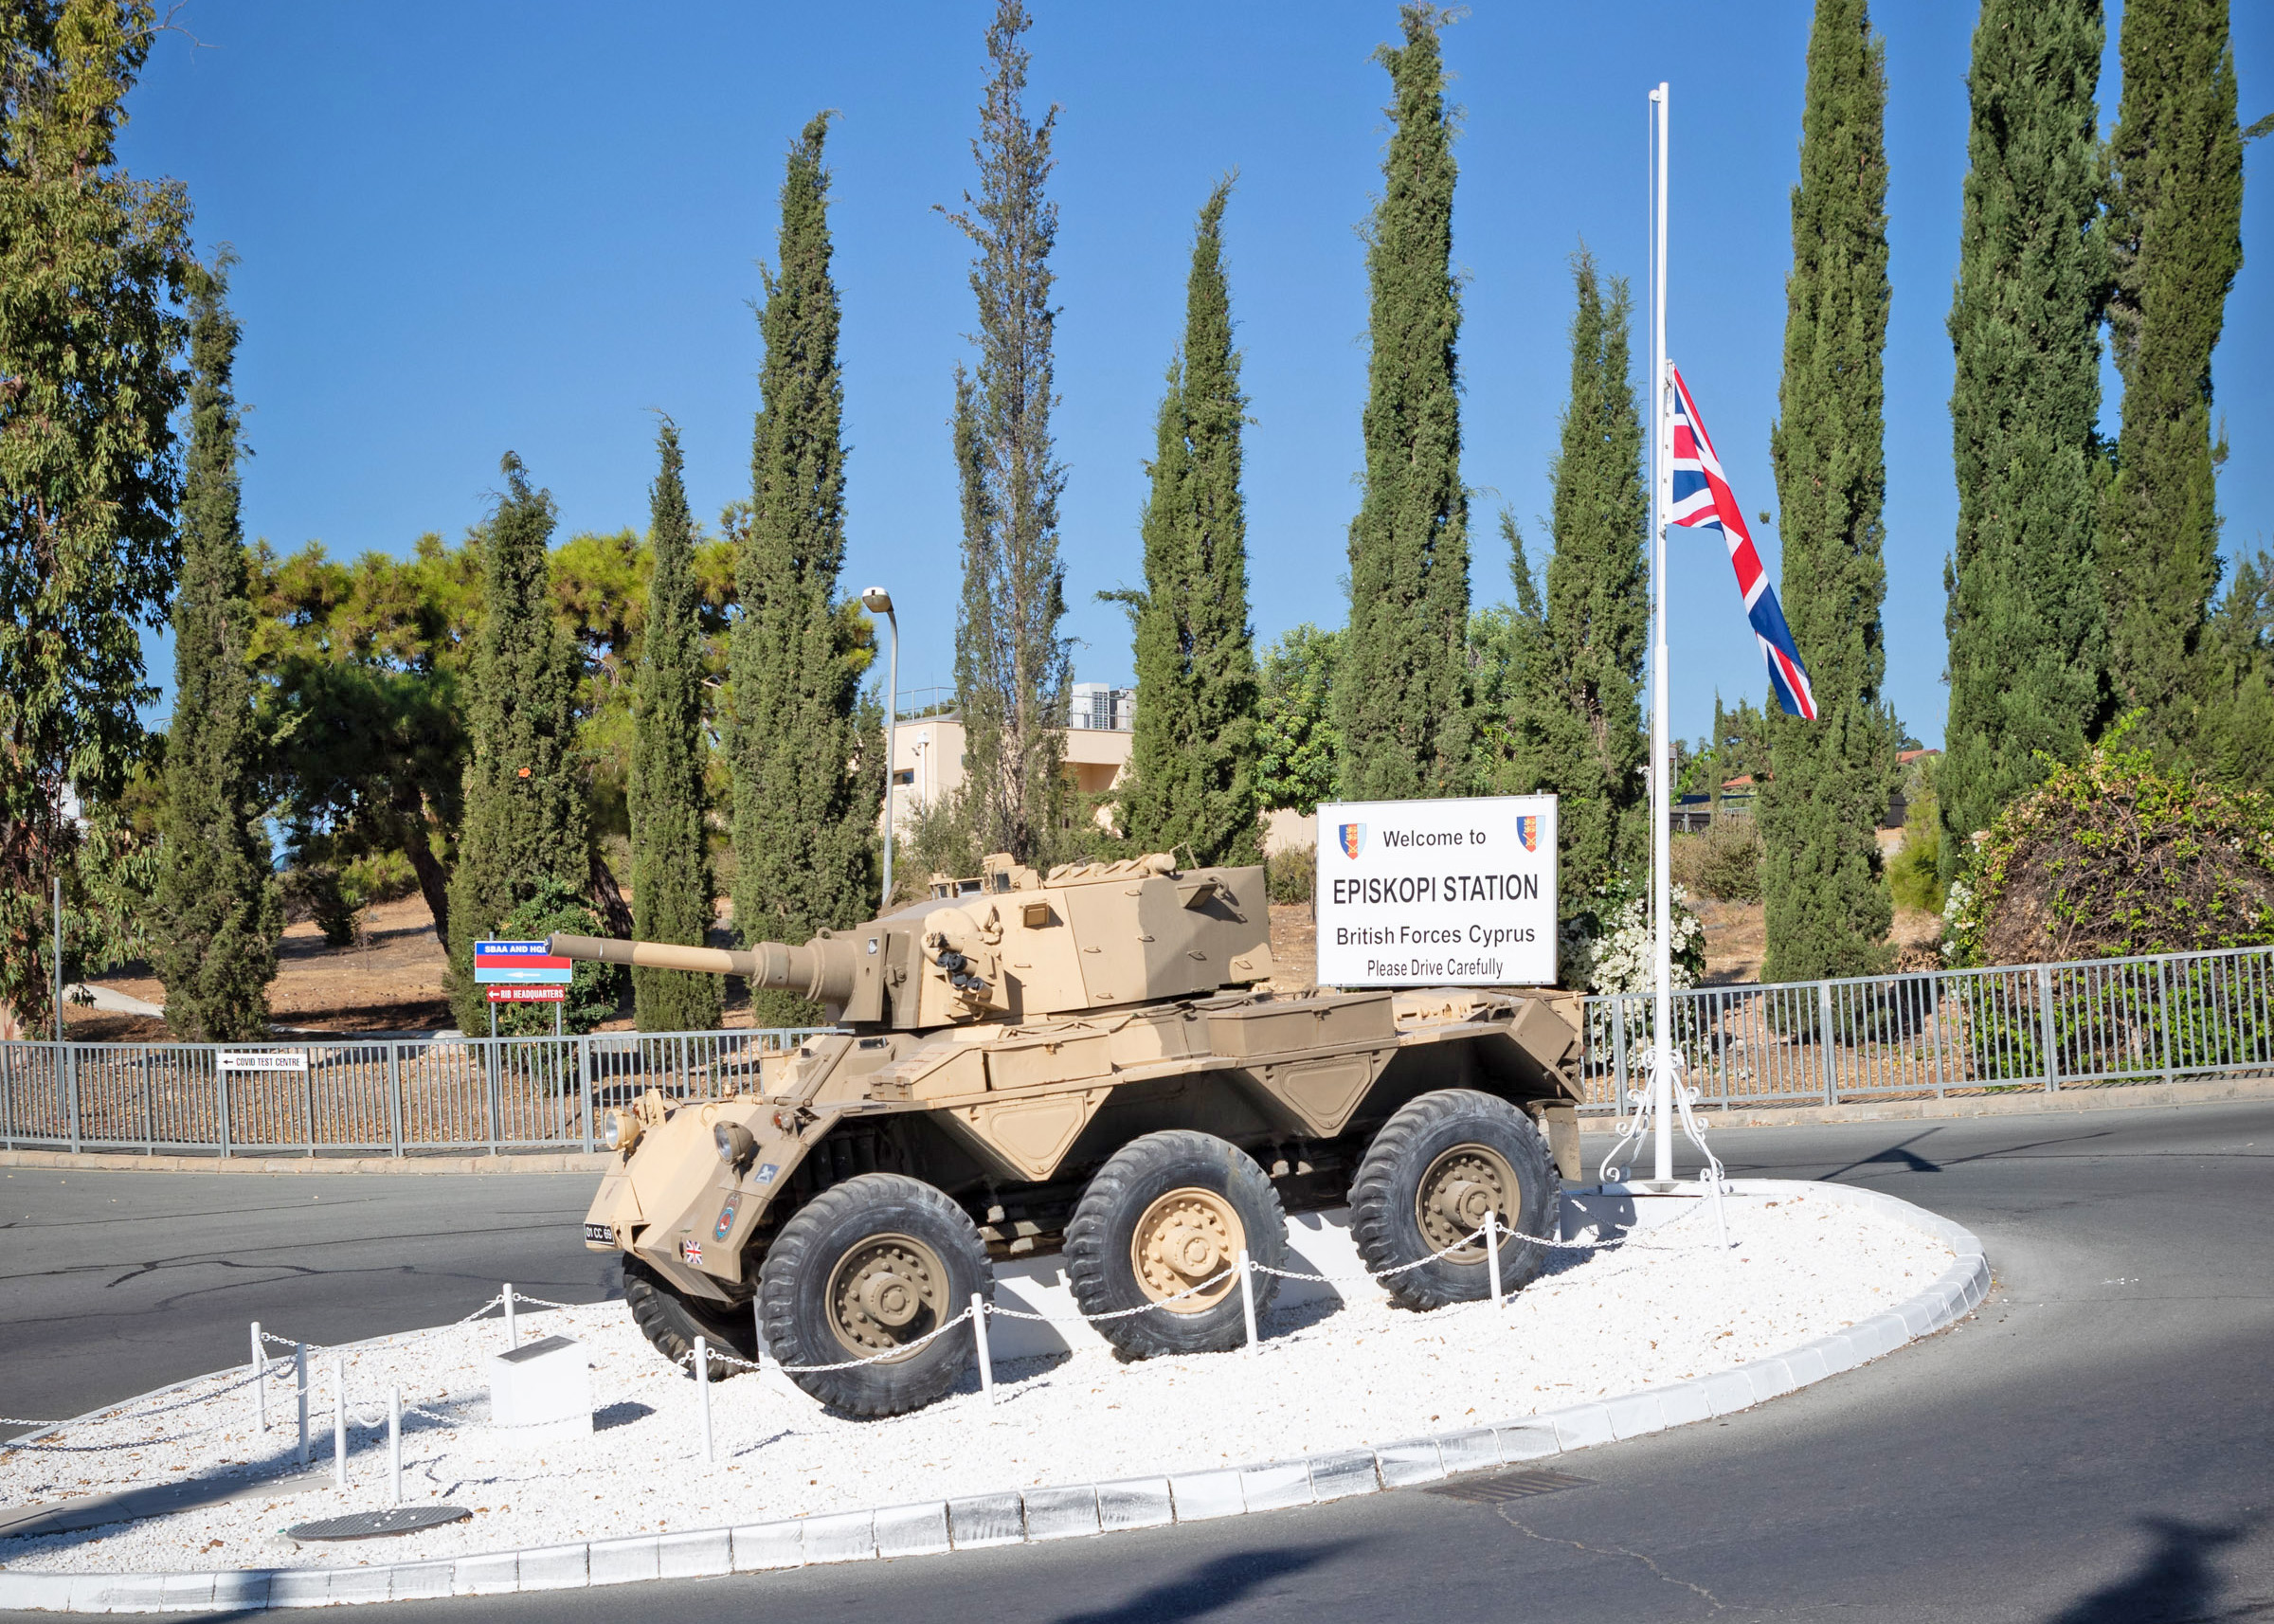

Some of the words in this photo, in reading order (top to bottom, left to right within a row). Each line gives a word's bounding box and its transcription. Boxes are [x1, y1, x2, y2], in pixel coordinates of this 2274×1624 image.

[1383, 831, 1462, 847] Welcome
[1470, 830, 1486, 844] to
[1334, 877, 1435, 904] EPISKOPI
[1444, 875, 1537, 901] STATION
[1338, 927, 1394, 945] British
[1401, 927, 1461, 944] Forces
[1470, 925, 1534, 947] Cyprus
[1368, 960, 1407, 976] Please
[1412, 960, 1442, 975] Drive
[1448, 958, 1503, 979] Carefully
[513, 989, 564, 1000] HEADQUARTERS
[236, 1057, 256, 1067] COVID
[257, 1057, 273, 1067] TEST
[275, 1057, 300, 1067] CENTRE
